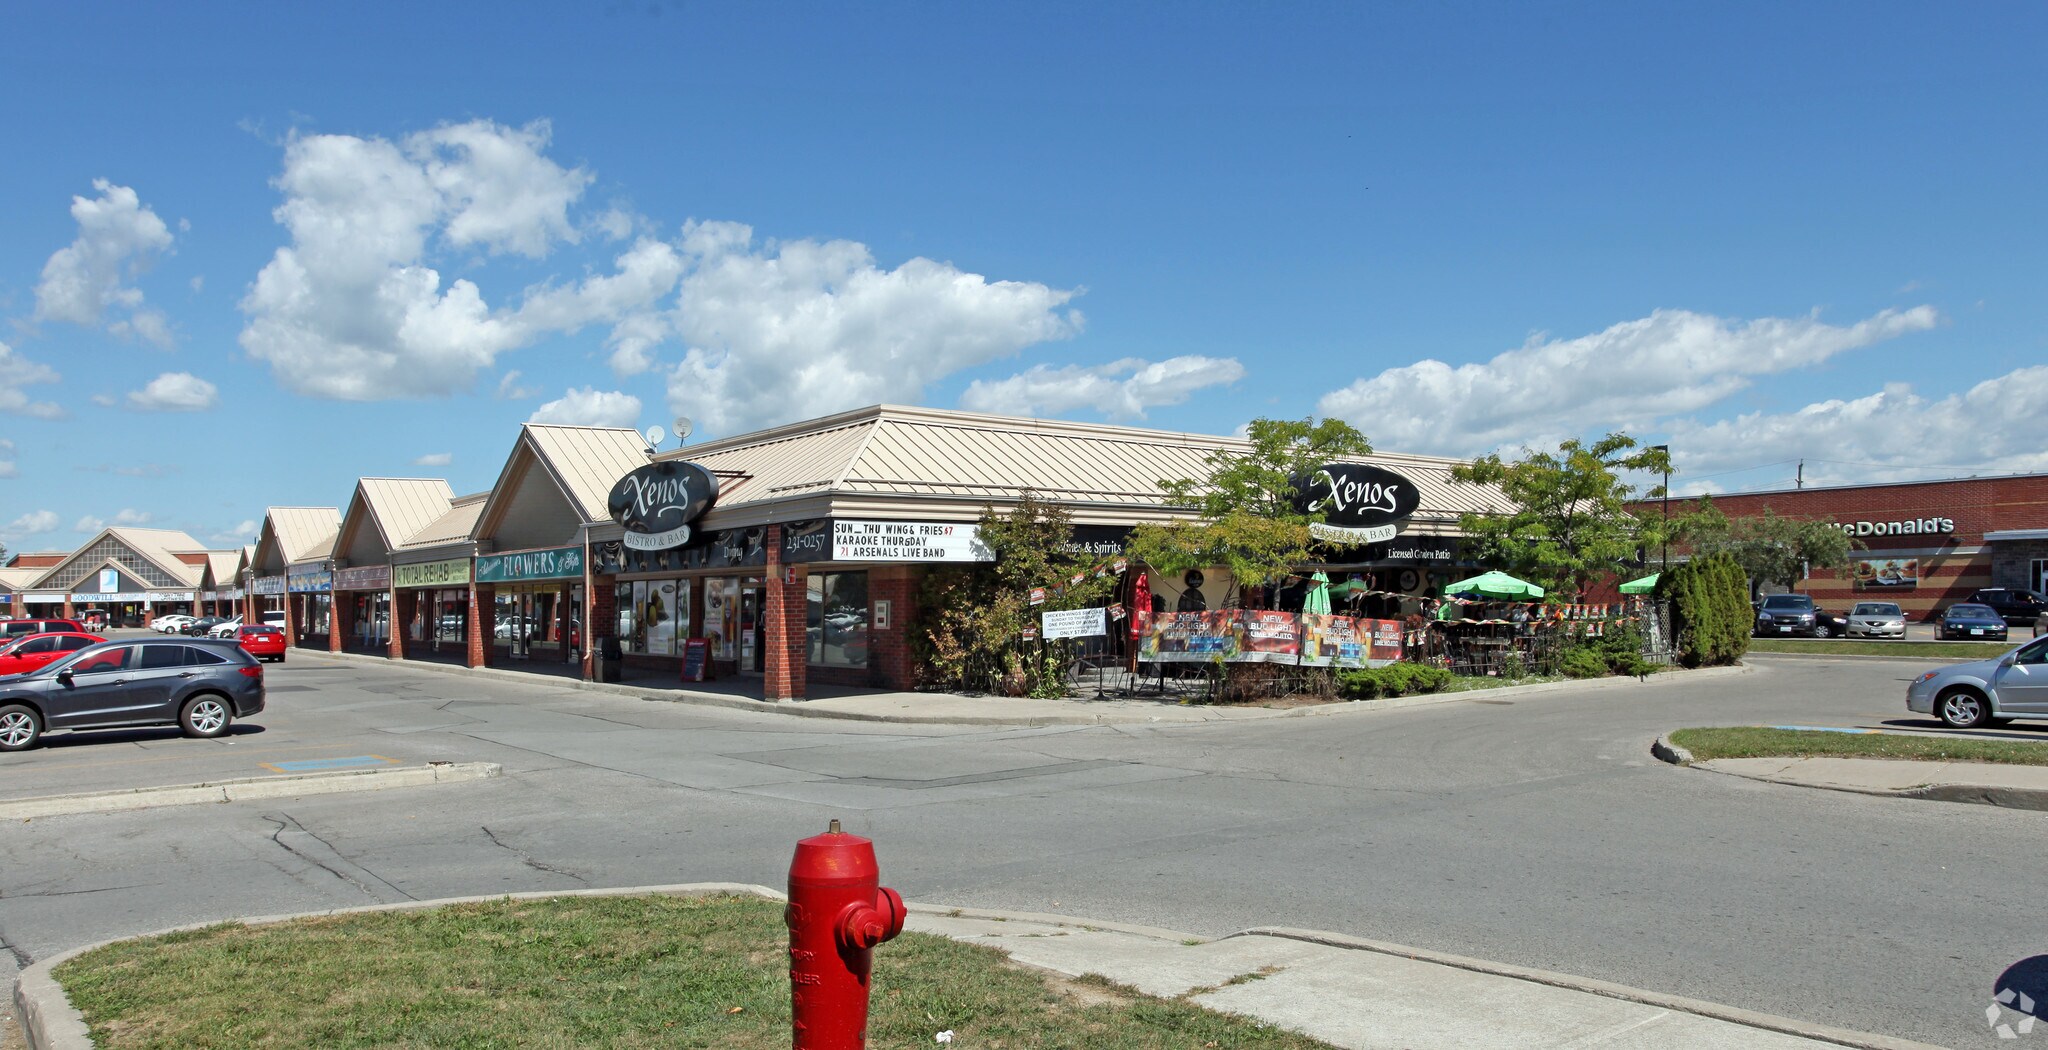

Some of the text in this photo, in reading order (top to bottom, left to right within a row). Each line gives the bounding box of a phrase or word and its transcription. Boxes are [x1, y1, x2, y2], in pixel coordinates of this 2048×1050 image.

[1308, 469, 1399, 515] Xenos
[623, 475, 690, 521] Xenos
[920, 526, 943, 536] FRIES
[1370, 528, 1392, 539] BAR
[627, 530, 687, 547] BISTRO & BAR
[787, 534, 826, 553] 231-0257
[836, 536, 878, 546] KARAOKE
[723, 546, 743, 562] Dining
[853, 547, 899, 557] ARSENALS
[902, 548, 921, 558] LIVE
[923, 549, 945, 558] BAND
[1084, 541, 1093, 553] &
[1094, 540, 1122, 558] Spirits
[1388, 547, 1414, 559] Licensed
[1435, 548, 1451, 560] Patio
[503, 551, 554, 577] FLOWERS
[402, 566, 423, 585] TOTAL
[424, 563, 450, 583] REHAB
[1178, 613, 1200, 621] NEW
[1262, 614, 1284, 622] NEW
[1251, 622, 1294, 632] BUD LIGHT
[1334, 620, 1348, 628] NEW
[1251, 631, 1294, 640] LIME MOJITO
[1326, 627, 1355, 637] BUD LIGHT
[1385, 632, 1400, 640] LIGHT
